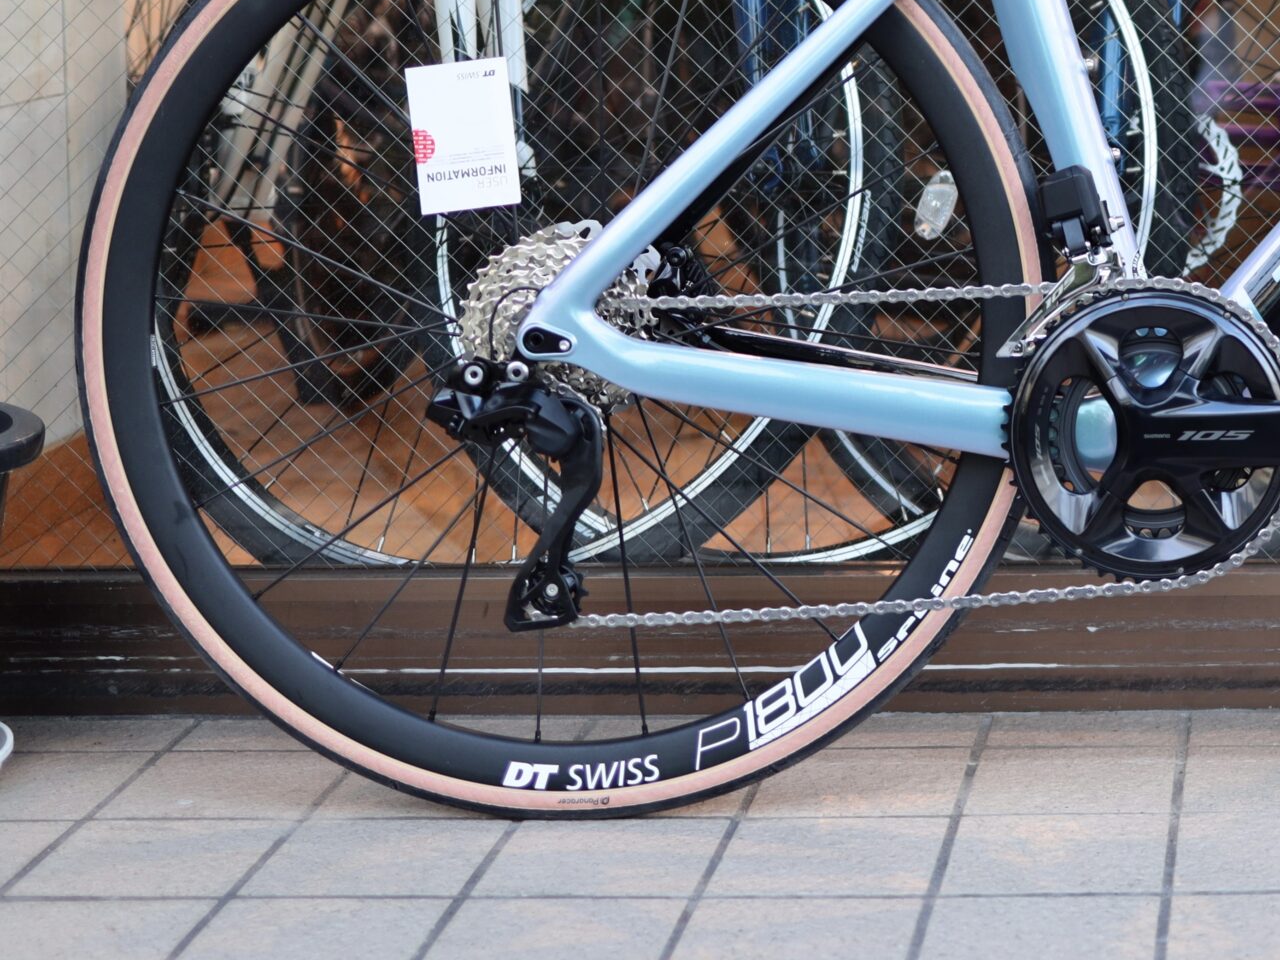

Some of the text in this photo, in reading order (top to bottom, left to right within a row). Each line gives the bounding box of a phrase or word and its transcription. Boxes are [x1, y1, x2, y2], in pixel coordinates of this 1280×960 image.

[482, 69, 496, 78] DT
[426, 163, 507, 183] INFORMATION
[1176, 430, 1254, 441] 105
[502, 754, 661, 791] DT SWISS
[557, 796, 599, 806] Panaracer
